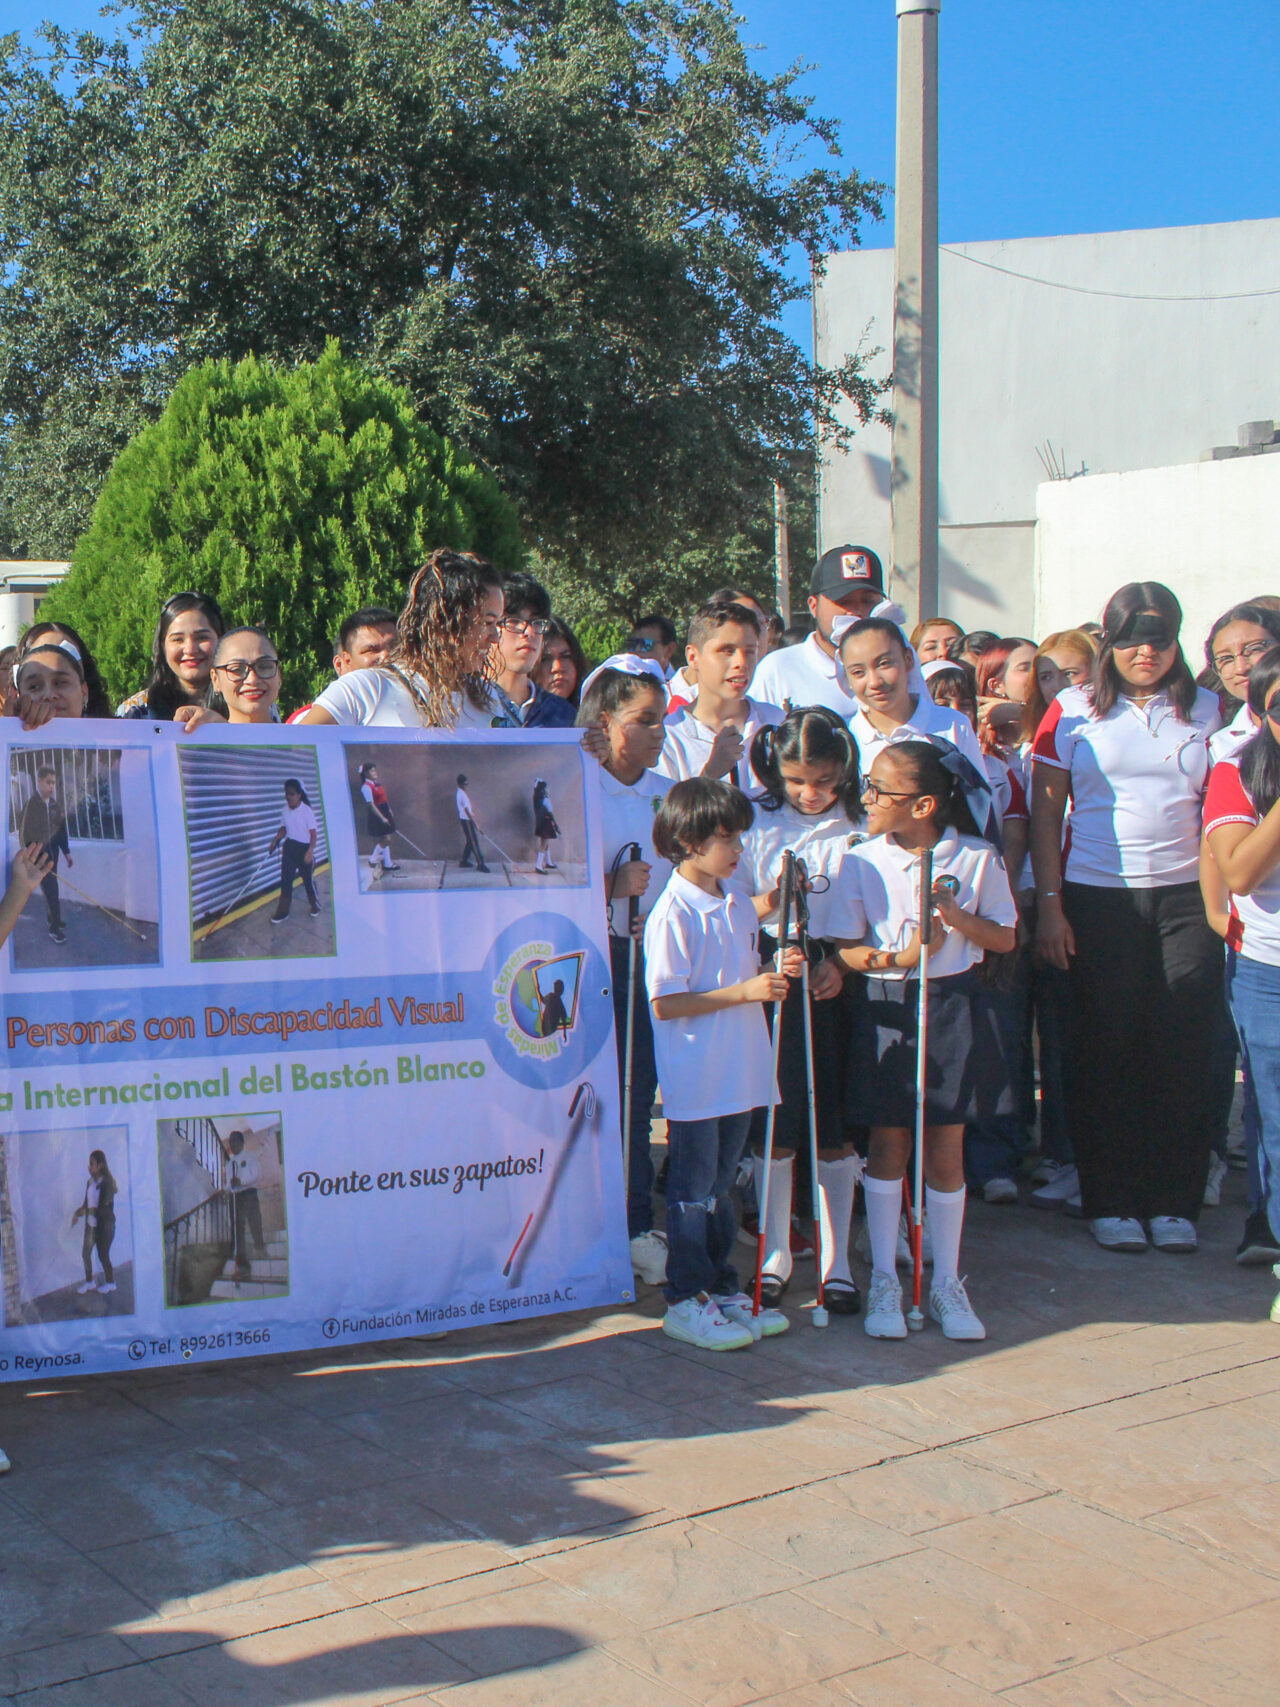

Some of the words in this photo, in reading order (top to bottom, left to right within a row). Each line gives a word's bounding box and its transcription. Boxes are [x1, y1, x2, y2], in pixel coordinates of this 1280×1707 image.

[494, 943, 552, 995] Esperanza
[6, 1016, 136, 1049] Personas
[143, 1015, 196, 1041] con
[205, 998, 383, 1041] Discapacidad
[387, 992, 465, 1027] Visual
[23, 1067, 230, 1112] Internacional
[239, 1064, 282, 1096] del
[291, 1060, 389, 1092] Bastón
[396, 1054, 486, 1084] Blanco
[297, 1170, 374, 1198] Ponte
[376, 1171, 407, 1190] en
[409, 1167, 450, 1188] sus
[452, 1148, 545, 1194] zapatos!
[342, 1312, 412, 1334] Fundación
[416, 1304, 467, 1324] Miradas
[470, 1300, 486, 1316] de
[489, 1292, 551, 1315] Esperanza
[553, 1287, 577, 1302] A.C.
[14, 1352, 86, 1373] Reynosa.
[149, 1340, 175, 1356] Tel.
[180, 1328, 271, 1352] 8992613666
